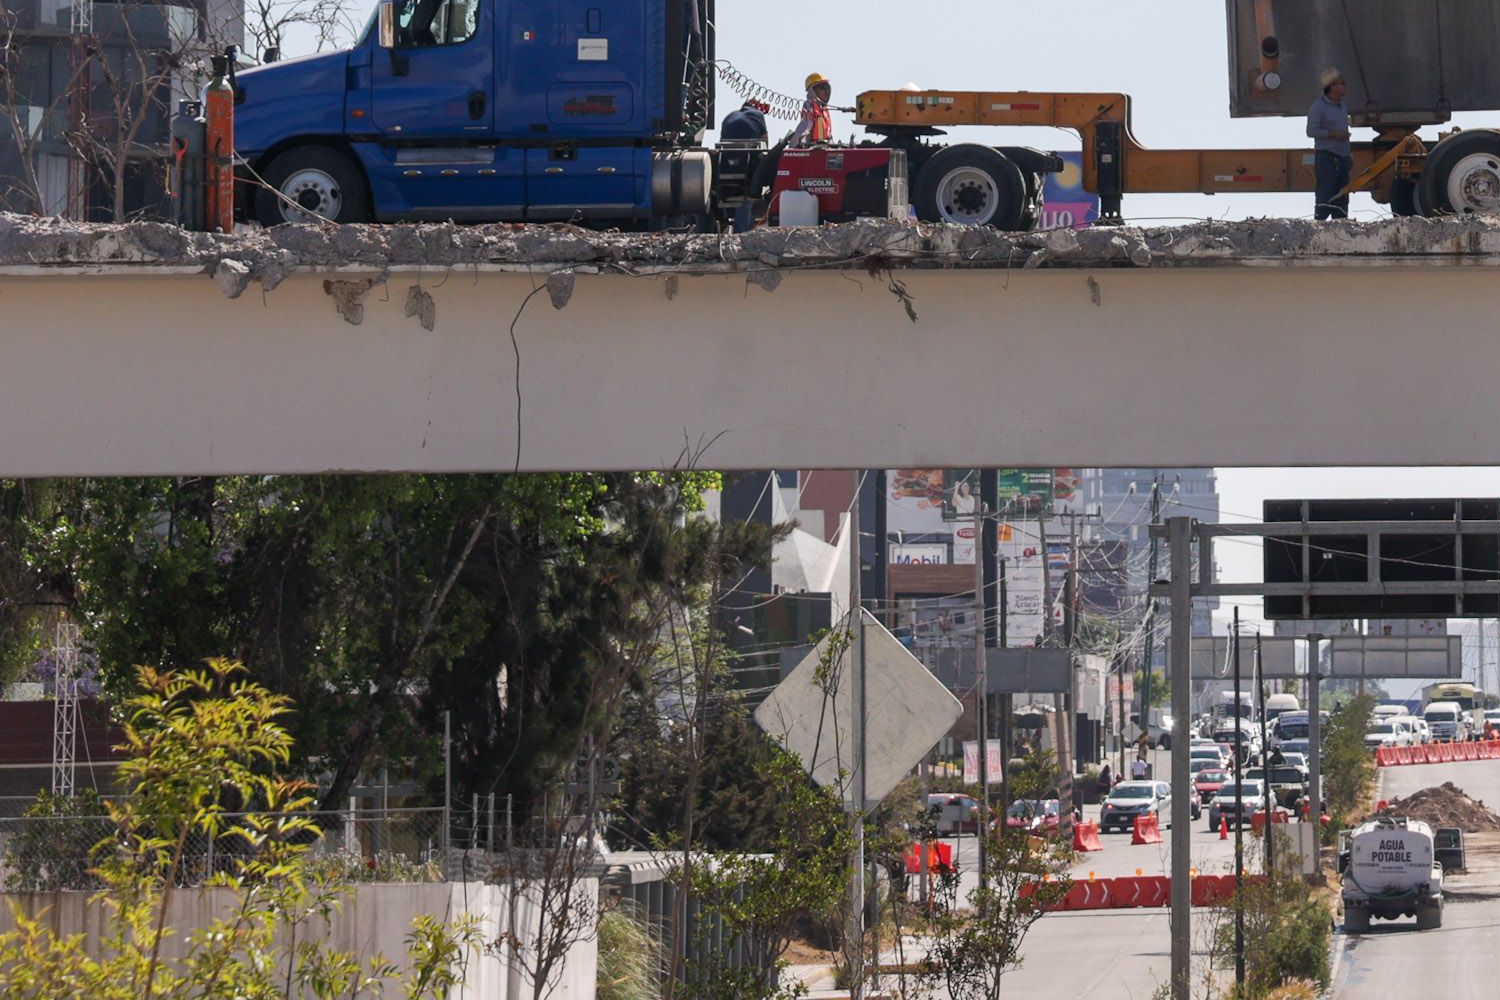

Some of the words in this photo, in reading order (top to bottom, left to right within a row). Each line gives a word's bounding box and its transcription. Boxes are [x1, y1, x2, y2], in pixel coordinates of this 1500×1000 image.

[897, 555, 940, 565] Mobil
[1379, 839, 1405, 850] AGUA
[1371, 851, 1412, 862] POTABLE
